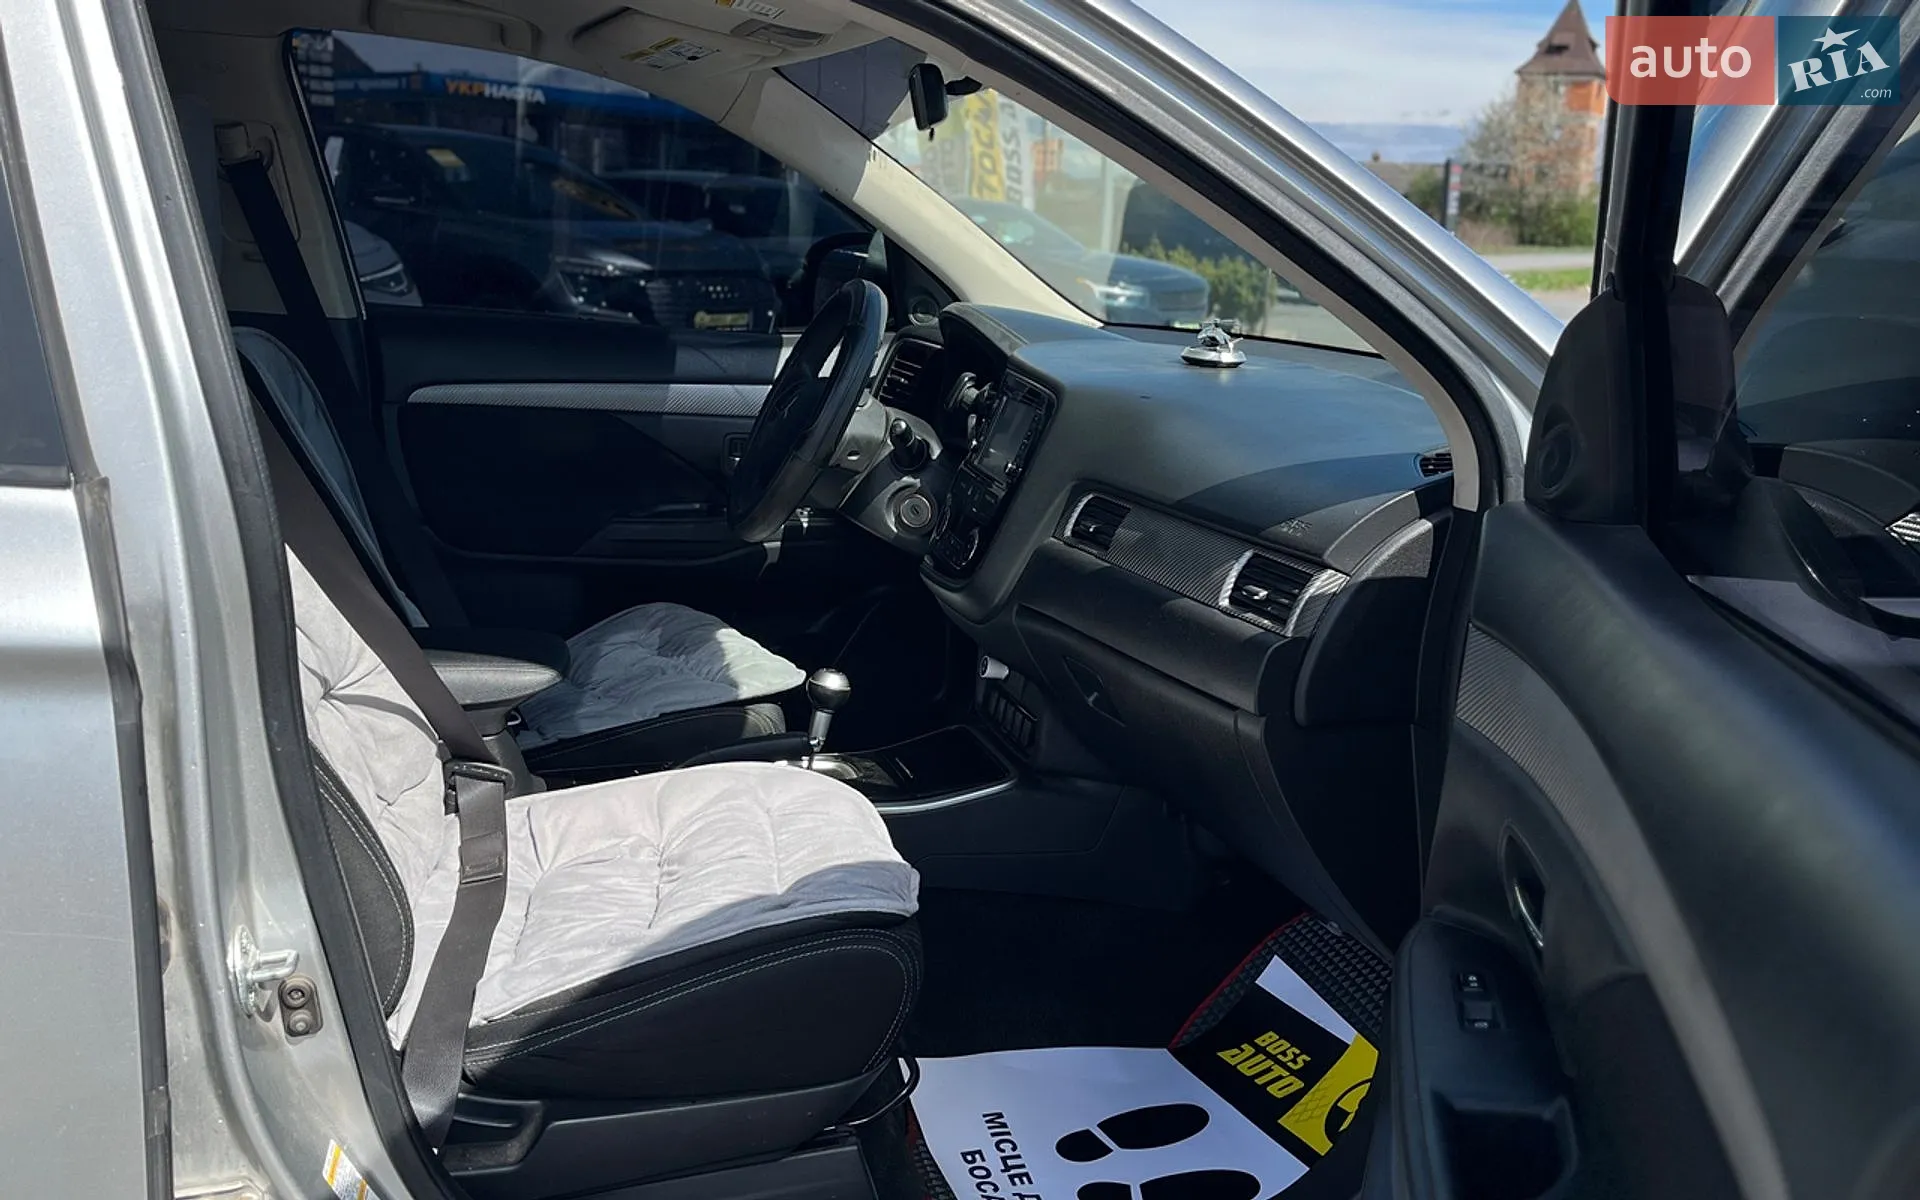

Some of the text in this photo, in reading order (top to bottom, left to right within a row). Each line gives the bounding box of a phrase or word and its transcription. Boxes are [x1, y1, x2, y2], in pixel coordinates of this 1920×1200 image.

[1216, 1043, 1305, 1099] AUTO
[1254, 1031, 1312, 1070] BOSS
[982, 1112, 1034, 1186] МІСЦЕ
